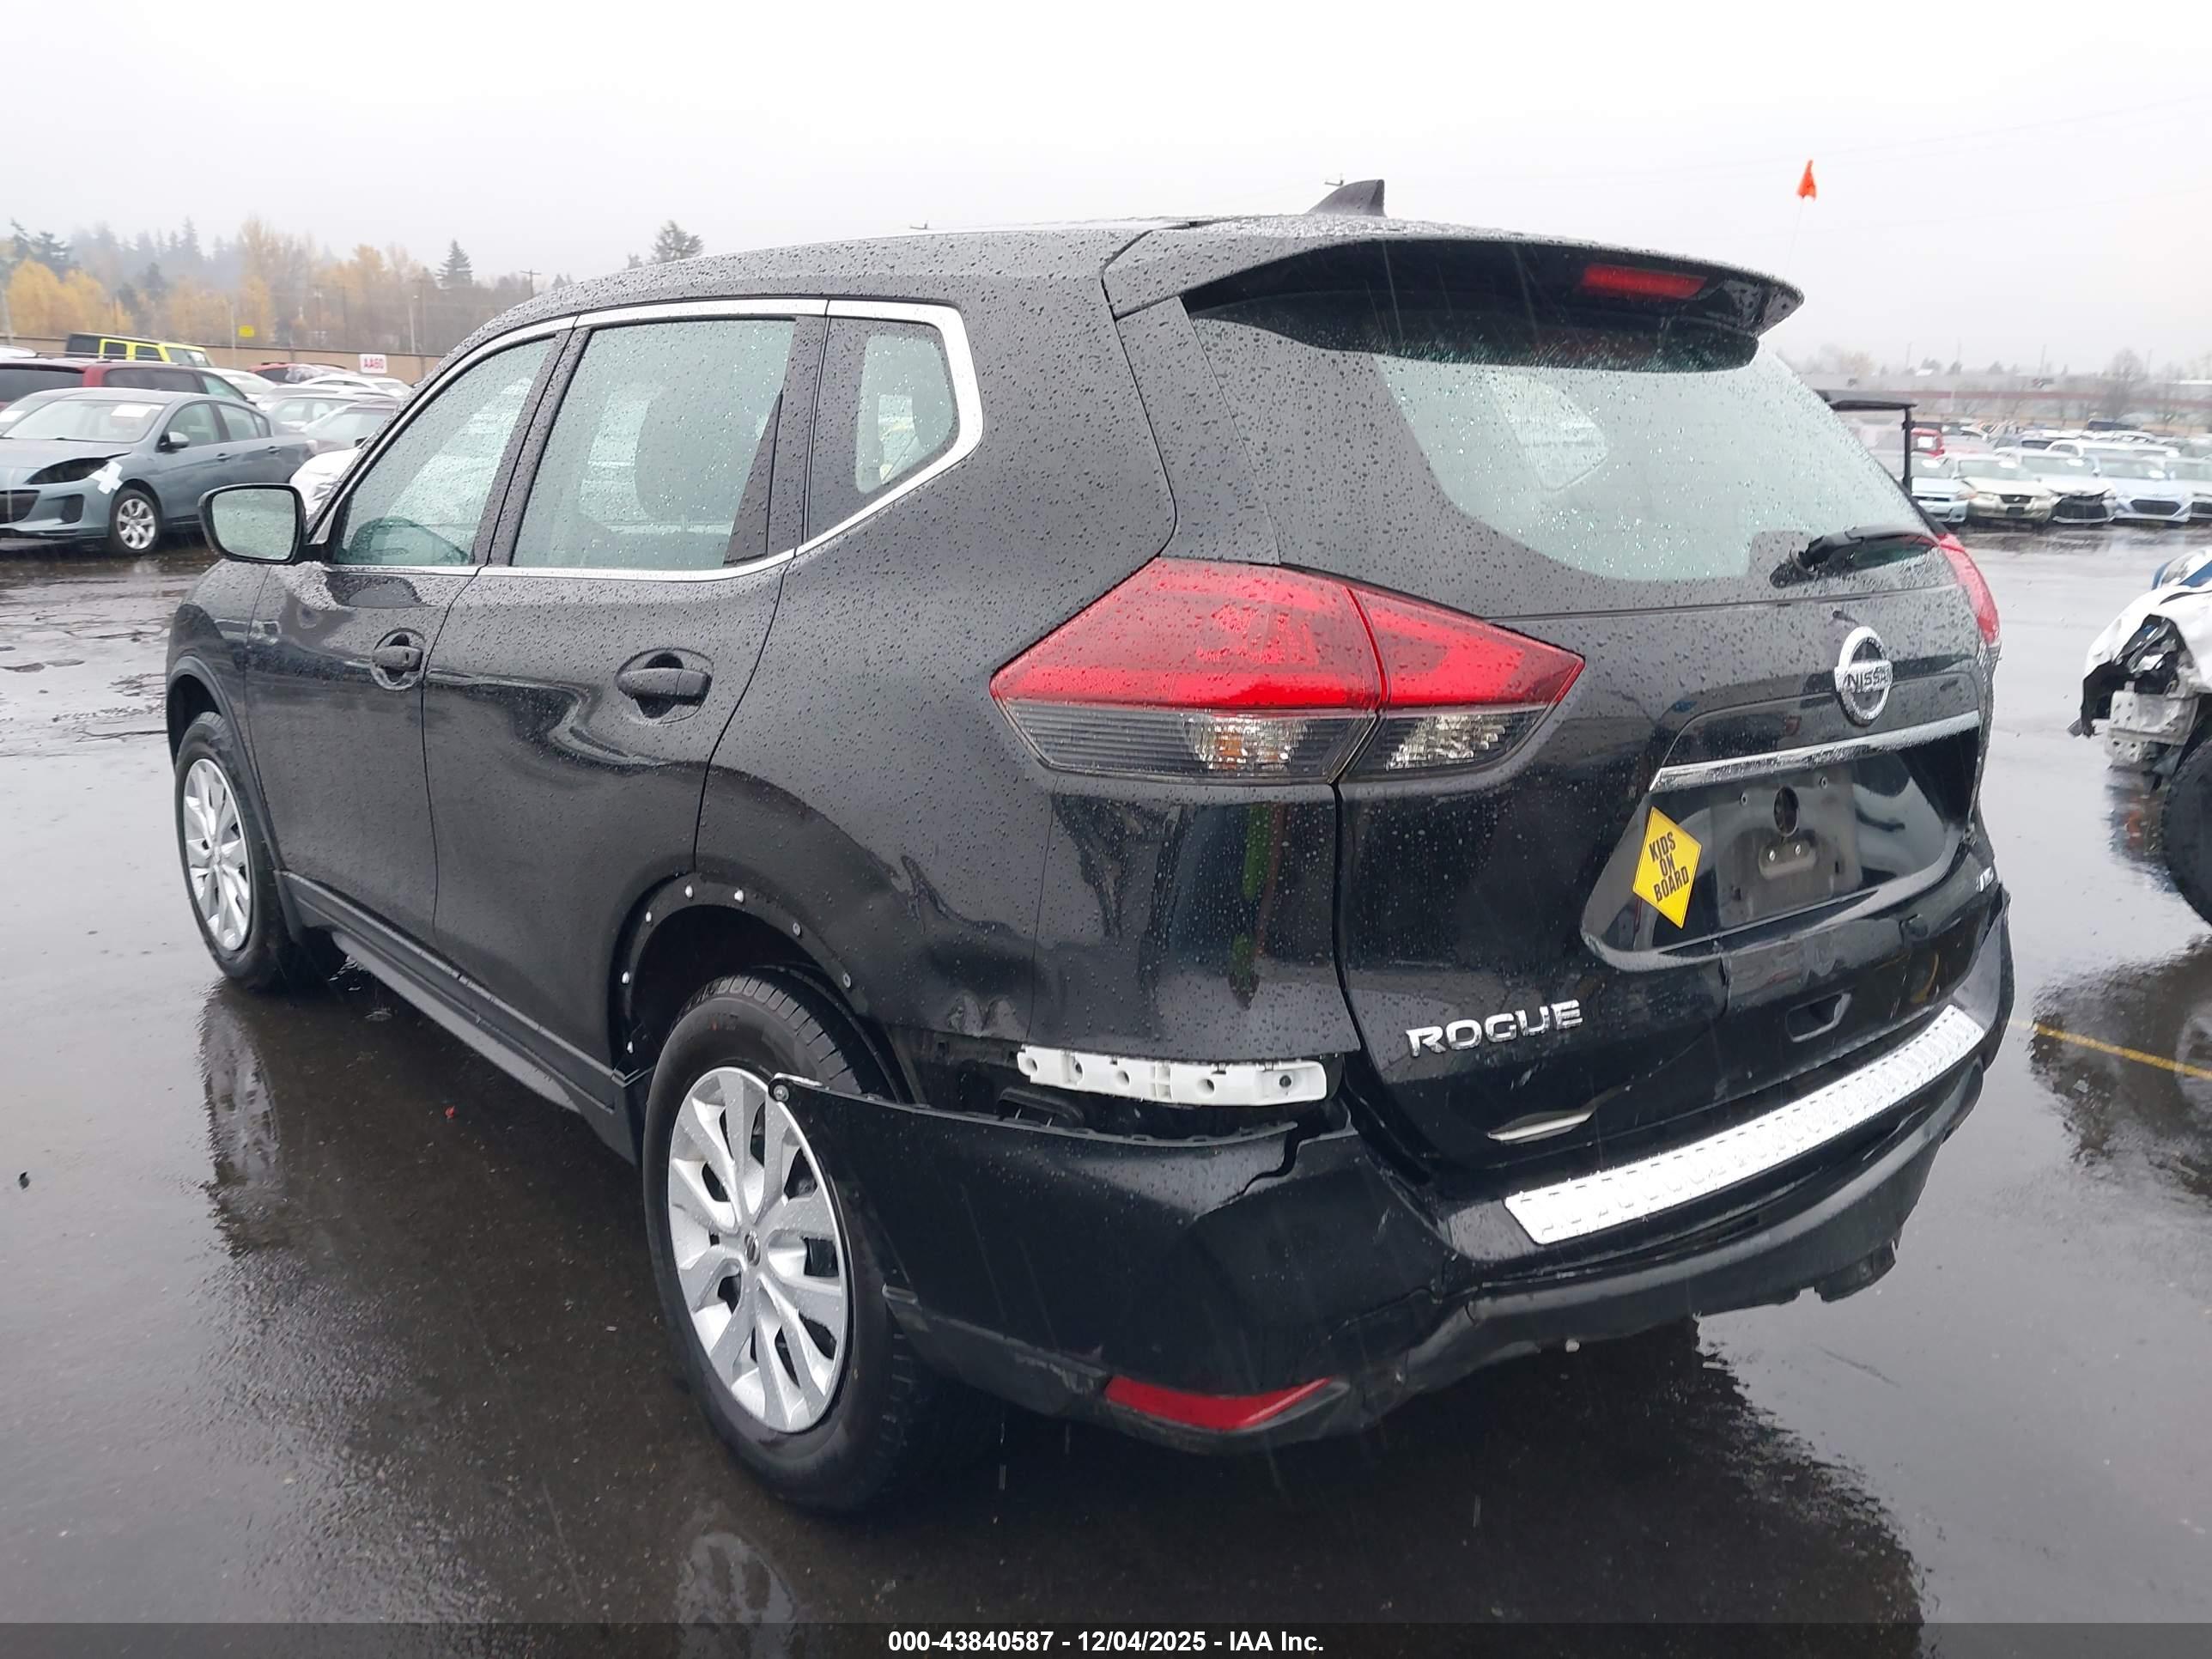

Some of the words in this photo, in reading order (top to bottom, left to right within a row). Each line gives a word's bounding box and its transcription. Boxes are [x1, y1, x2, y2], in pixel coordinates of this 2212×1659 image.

[1649, 831, 1676, 862] KIDS
[1659, 853, 1676, 876] ON
[1653, 866, 1689, 902] BOARD
[1406, 1000, 1583, 1057] ROGUE
